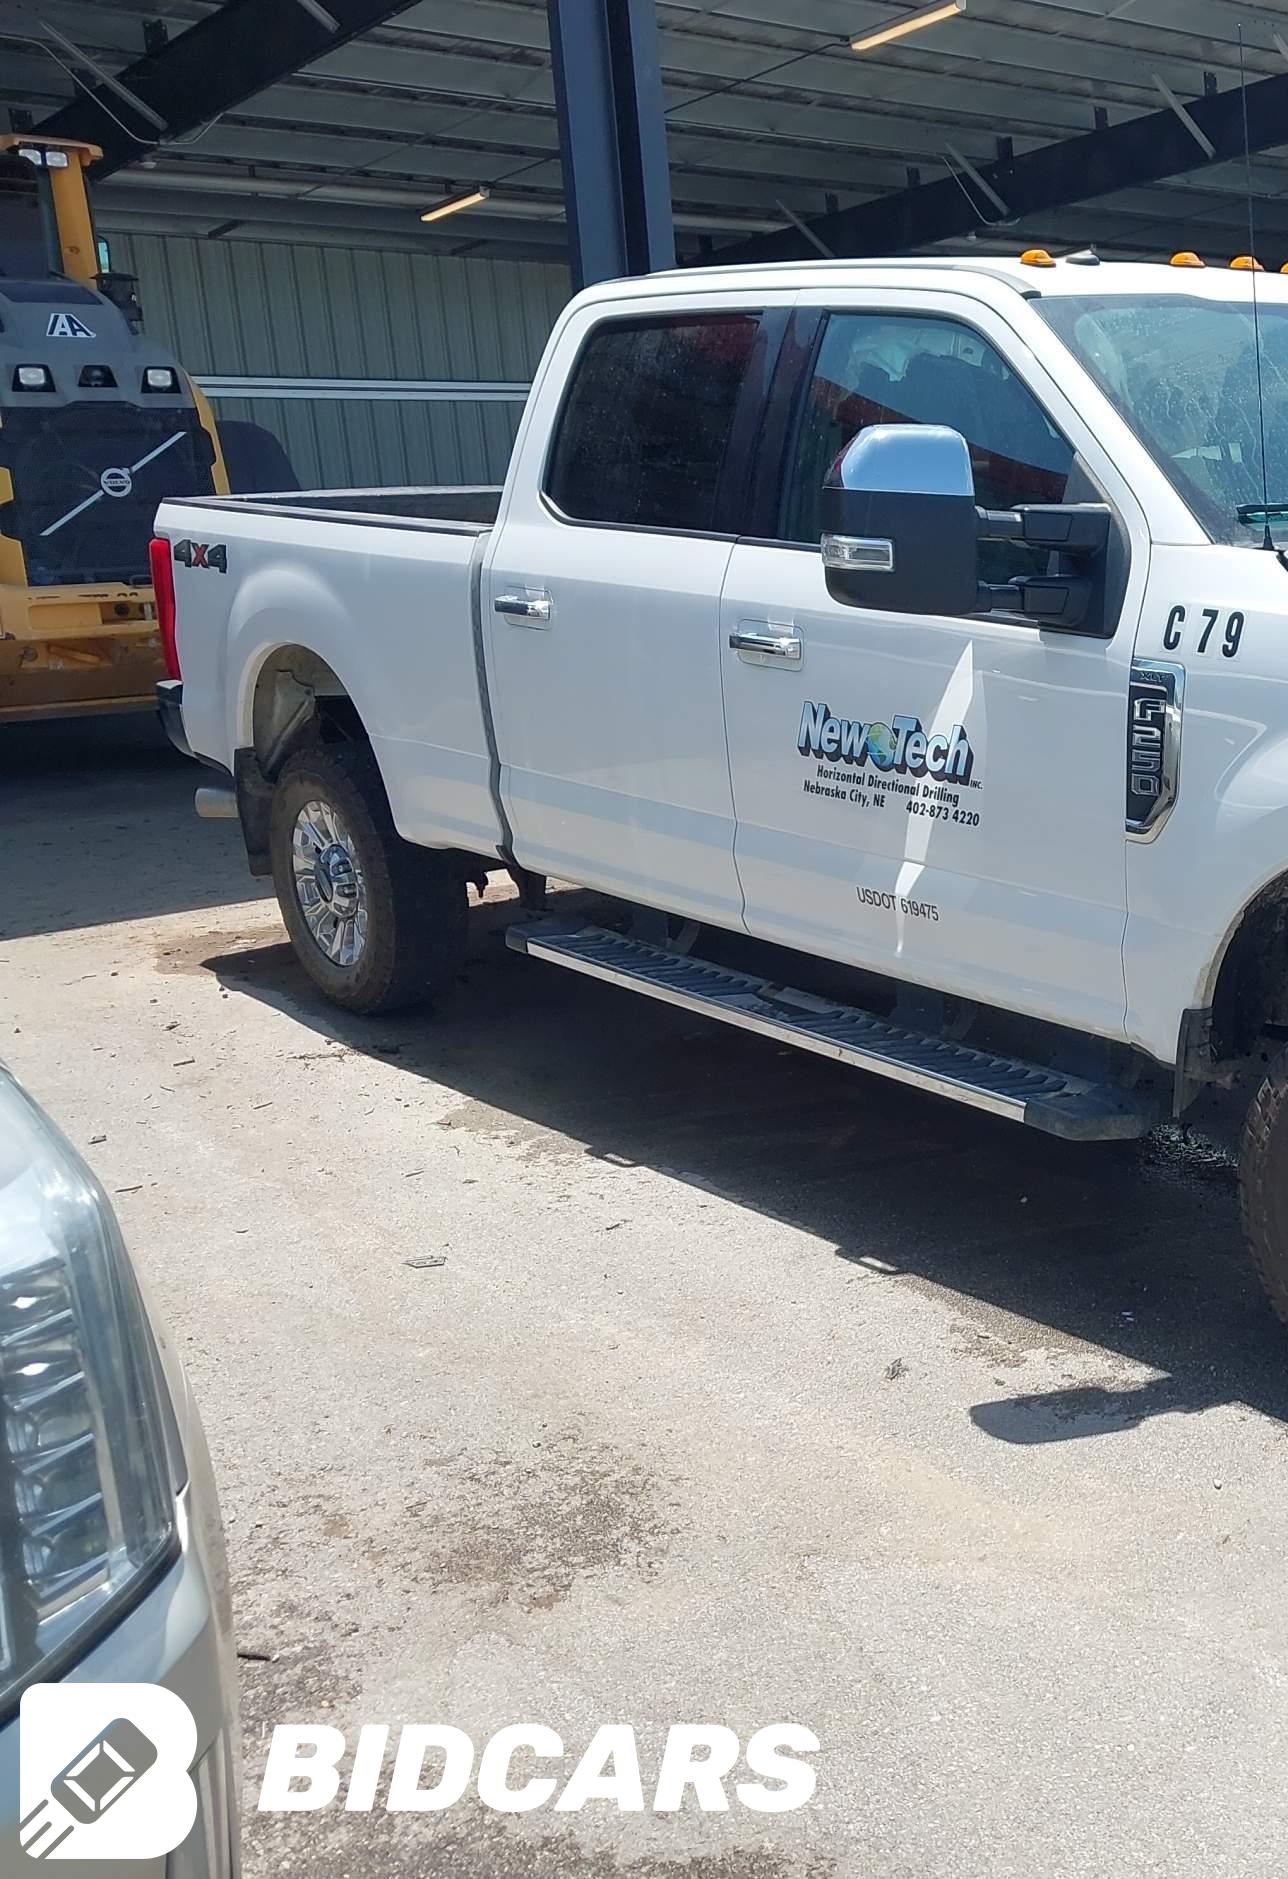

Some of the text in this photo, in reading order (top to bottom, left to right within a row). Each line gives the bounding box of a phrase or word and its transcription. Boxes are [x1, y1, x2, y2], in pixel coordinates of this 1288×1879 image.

[1163, 605, 1245, 658] C 79
[1139, 671, 1163, 683] XLT
[892, 715, 974, 786] Tech
[803, 780, 886, 808] Nebraska City, NE
[816, 765, 960, 807] Horizontal Directional Drilling
[905, 800, 980, 827] 402-873 4220
[856, 886, 939, 921] USDOT 619475
